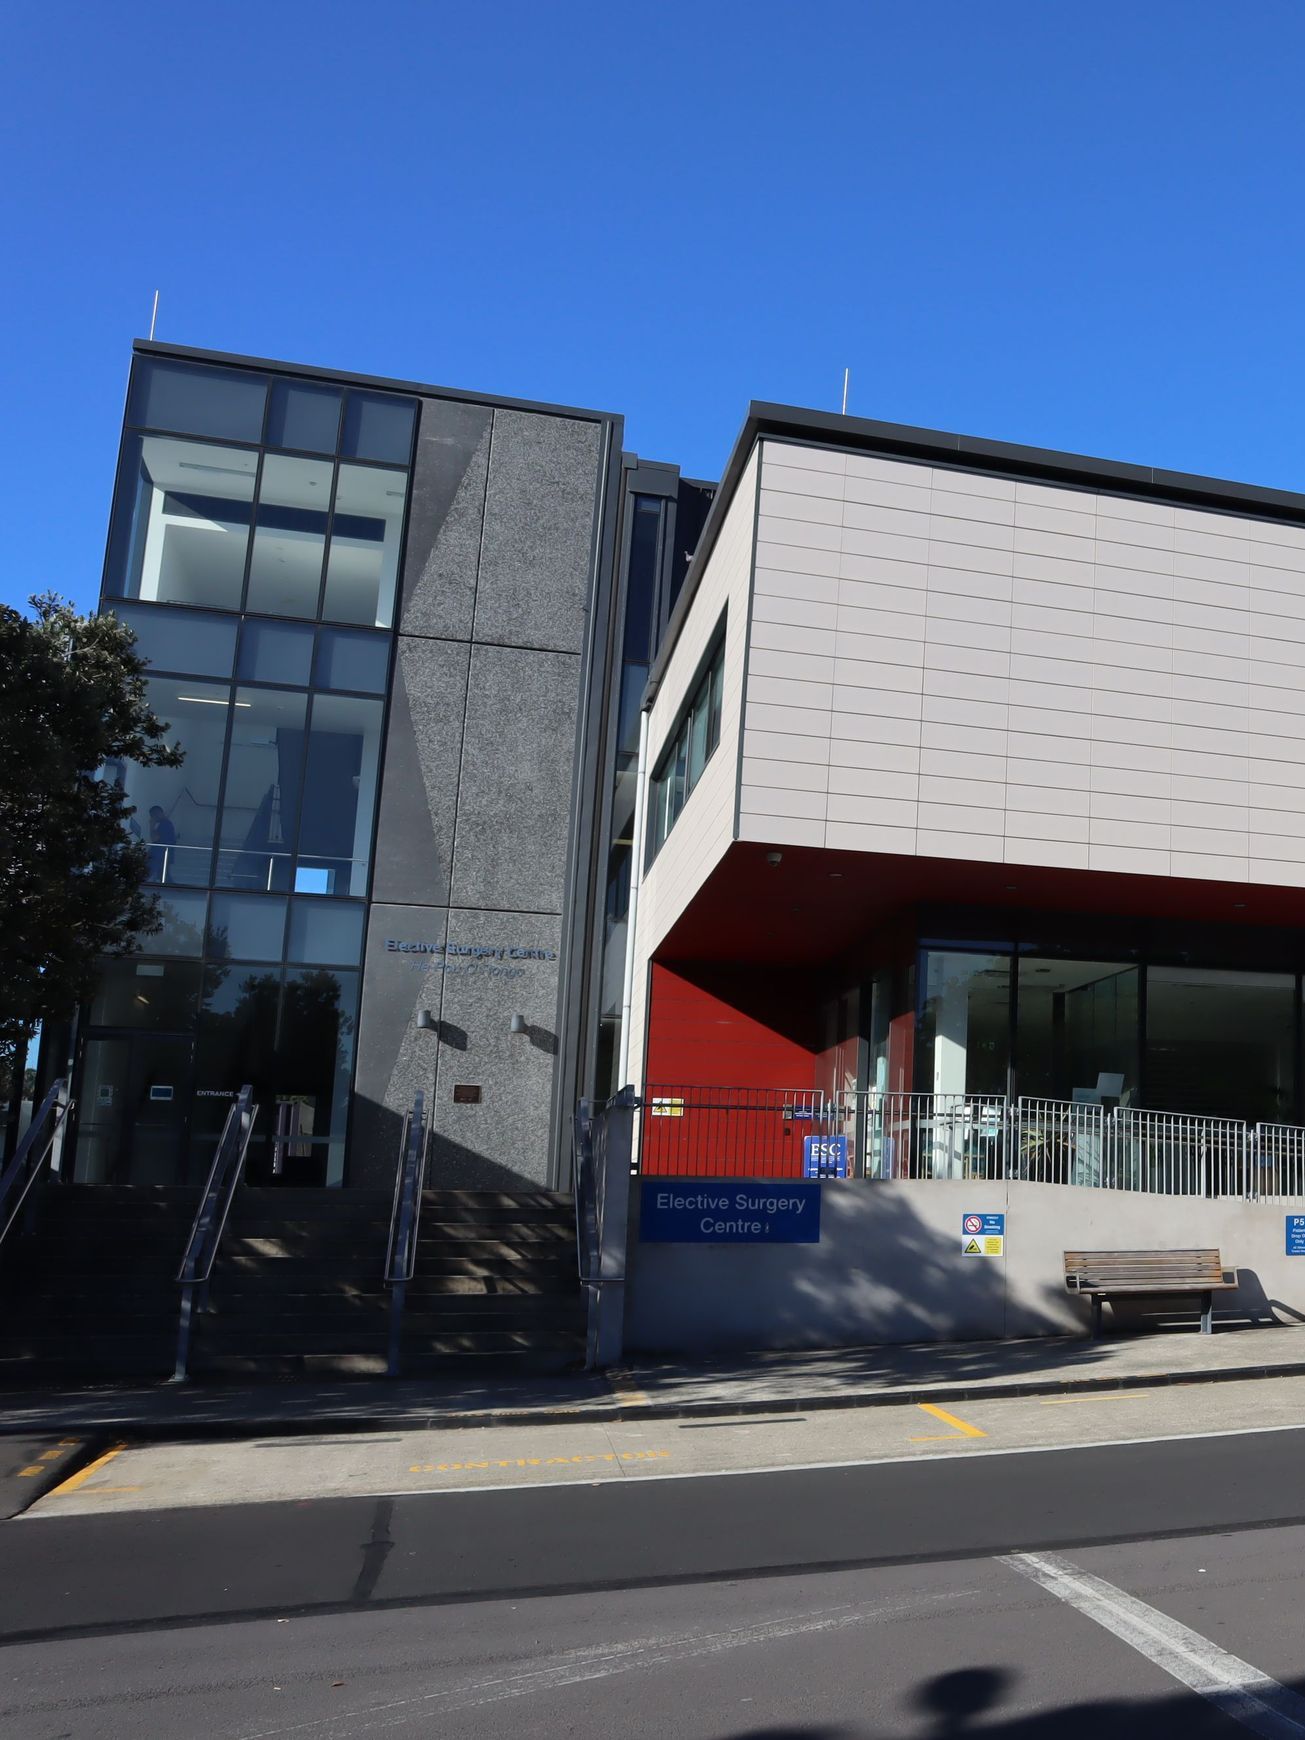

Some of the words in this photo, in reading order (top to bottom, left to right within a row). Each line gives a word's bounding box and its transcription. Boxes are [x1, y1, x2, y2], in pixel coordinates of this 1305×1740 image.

[384, 938, 444, 953] Elective
[446, 942, 504, 960] Surgery
[508, 944, 557, 961] Centre
[811, 1143, 841, 1156] ESC
[656, 1193, 730, 1210] Elective
[735, 1194, 806, 1214] Surgery
[700, 1217, 762, 1234] Centre
[409, 1449, 671, 1473] CONTRACTOR
